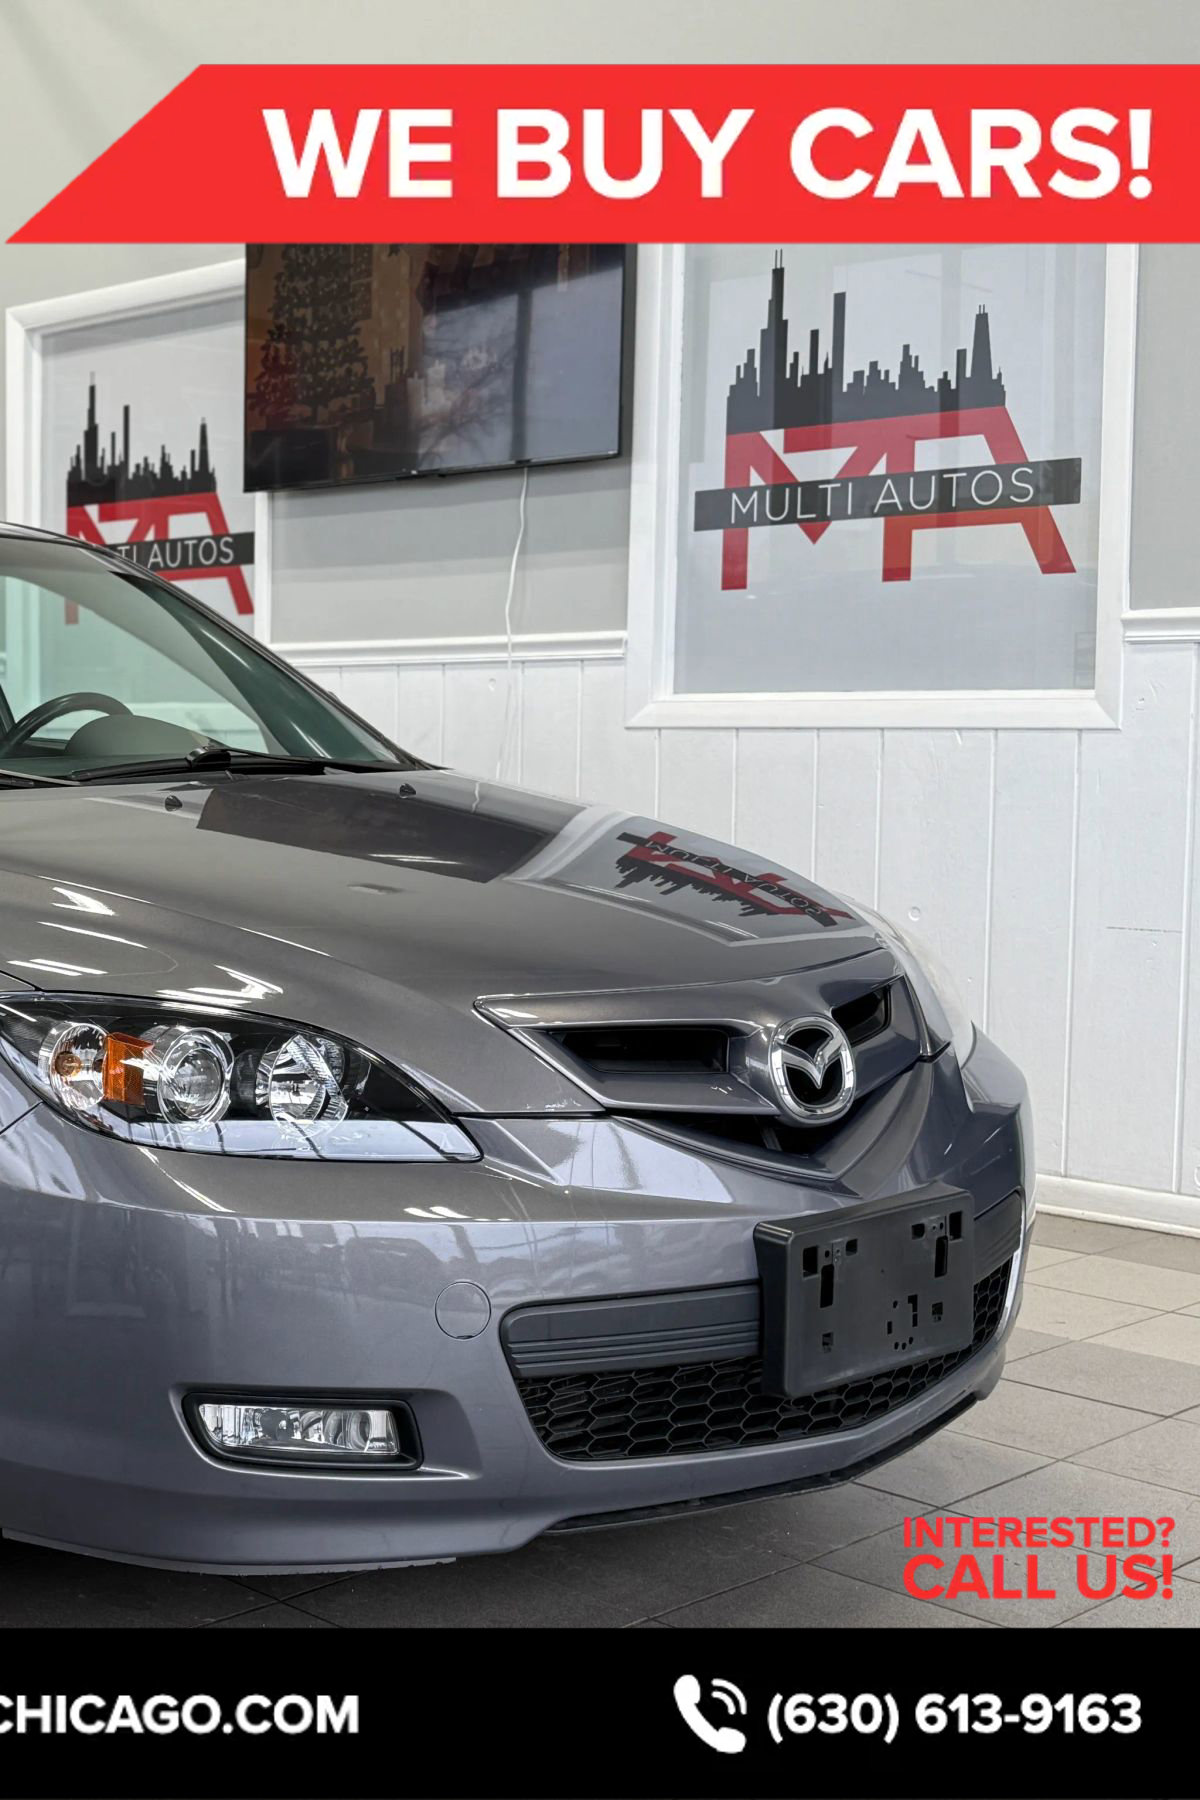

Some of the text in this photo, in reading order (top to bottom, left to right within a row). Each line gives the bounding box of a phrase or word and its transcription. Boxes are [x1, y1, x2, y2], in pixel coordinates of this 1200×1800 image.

[731, 467, 1034, 524] MULTI AUTOS
[147, 537, 234, 569] AUTOS
